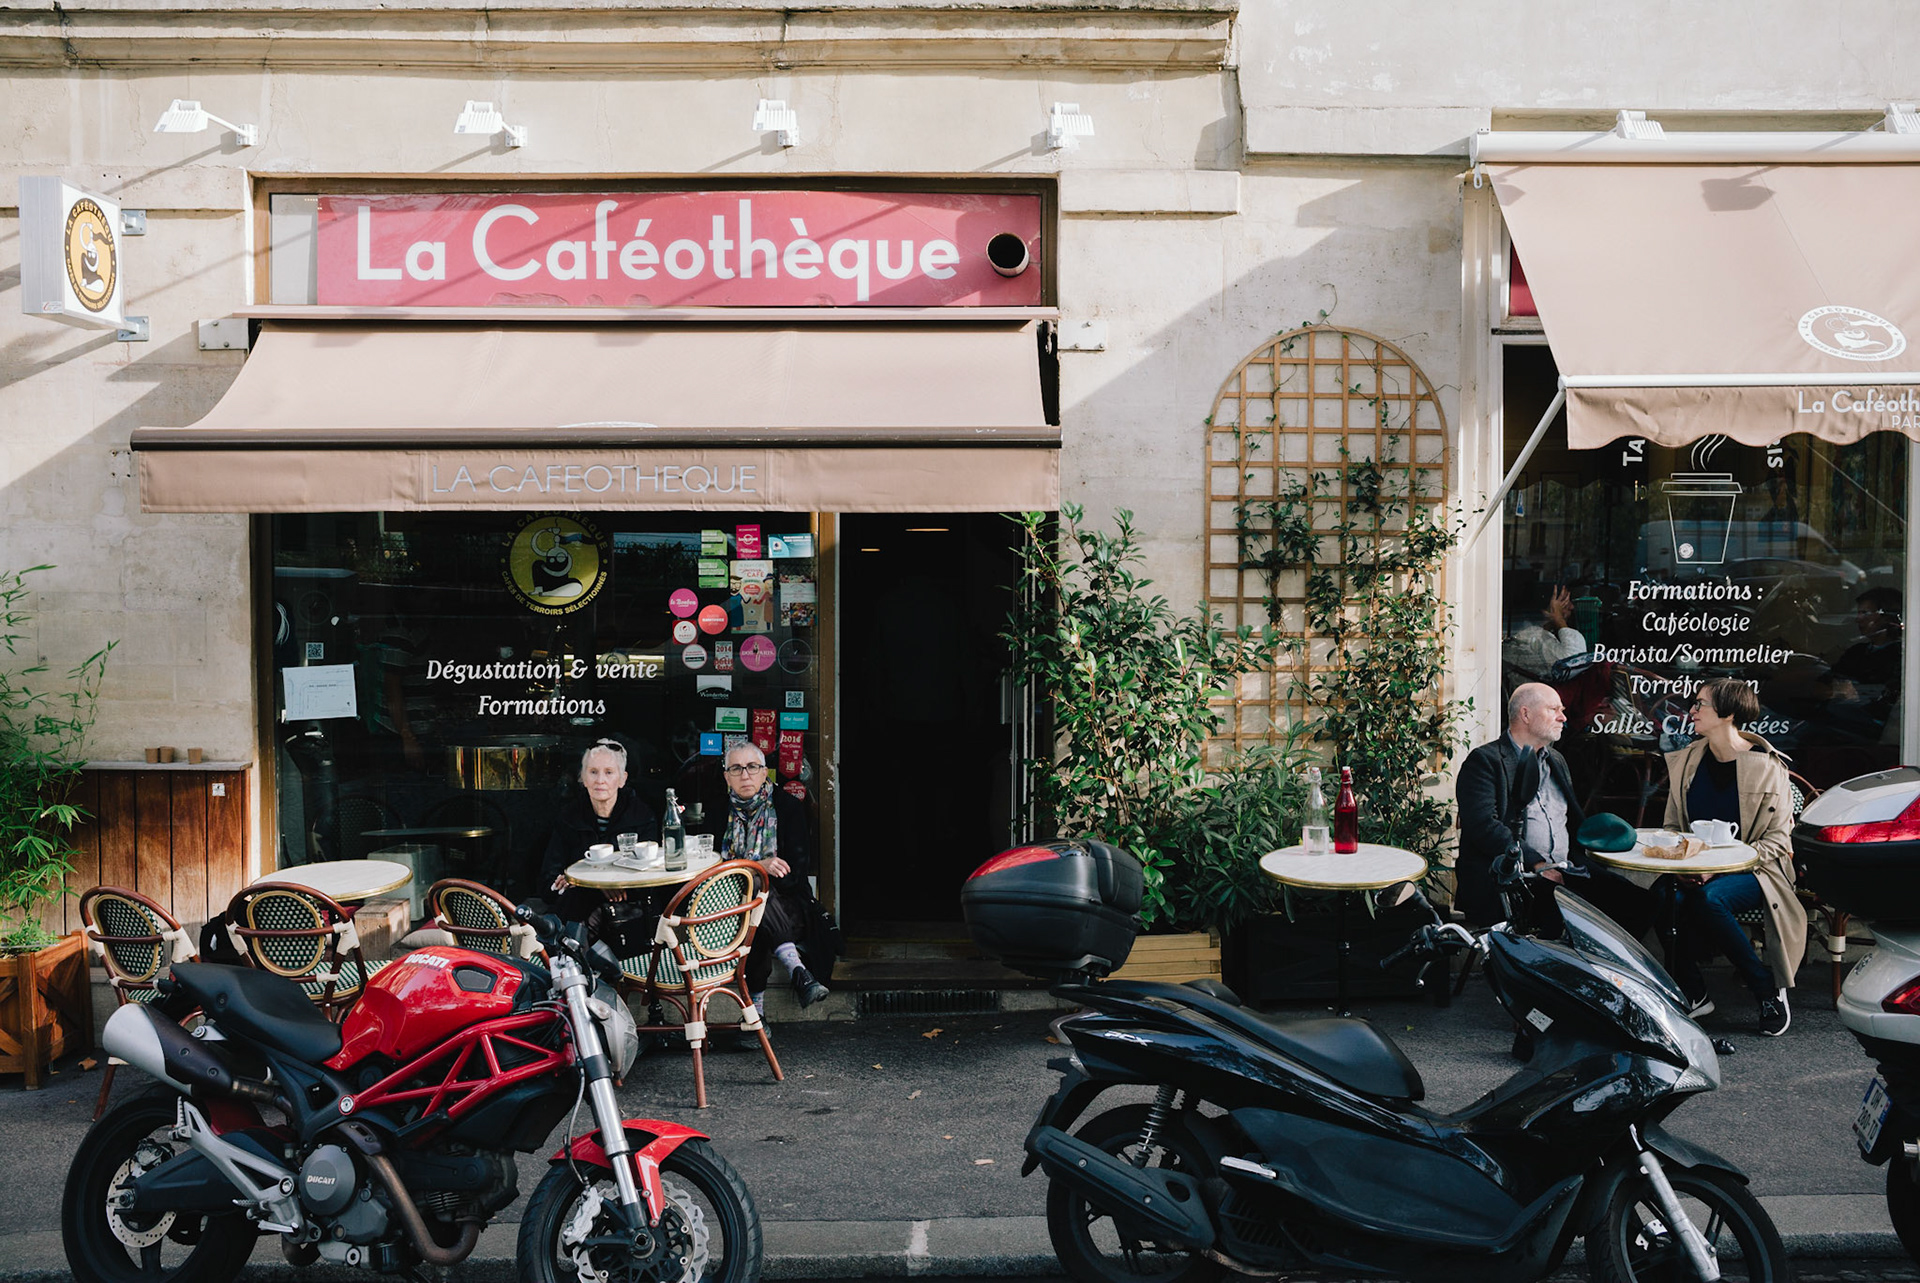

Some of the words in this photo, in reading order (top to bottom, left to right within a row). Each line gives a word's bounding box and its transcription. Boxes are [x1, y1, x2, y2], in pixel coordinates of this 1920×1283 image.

[357, 205, 446, 281] La
[471, 199, 959, 302] Caféothèque
[1798, 391, 1825, 413] La
[432, 464, 476, 493] LA
[489, 464, 757, 495] CAFEOTHEQUE
[502, 531, 516, 547] LA
[1627, 581, 1752, 601] Formations
[1642, 612, 1750, 636] Caféologie
[1592, 644, 1794, 665] Barista/Sommelier
[426, 659, 562, 684] Dégustation
[570, 659, 587, 679] &
[595, 660, 658, 679] vente
[478, 695, 607, 716] Formations
[1591, 713, 1654, 735] Salles
[404, 954, 450, 968] DUCATI
[307, 1175, 335, 1185] DUCATI
